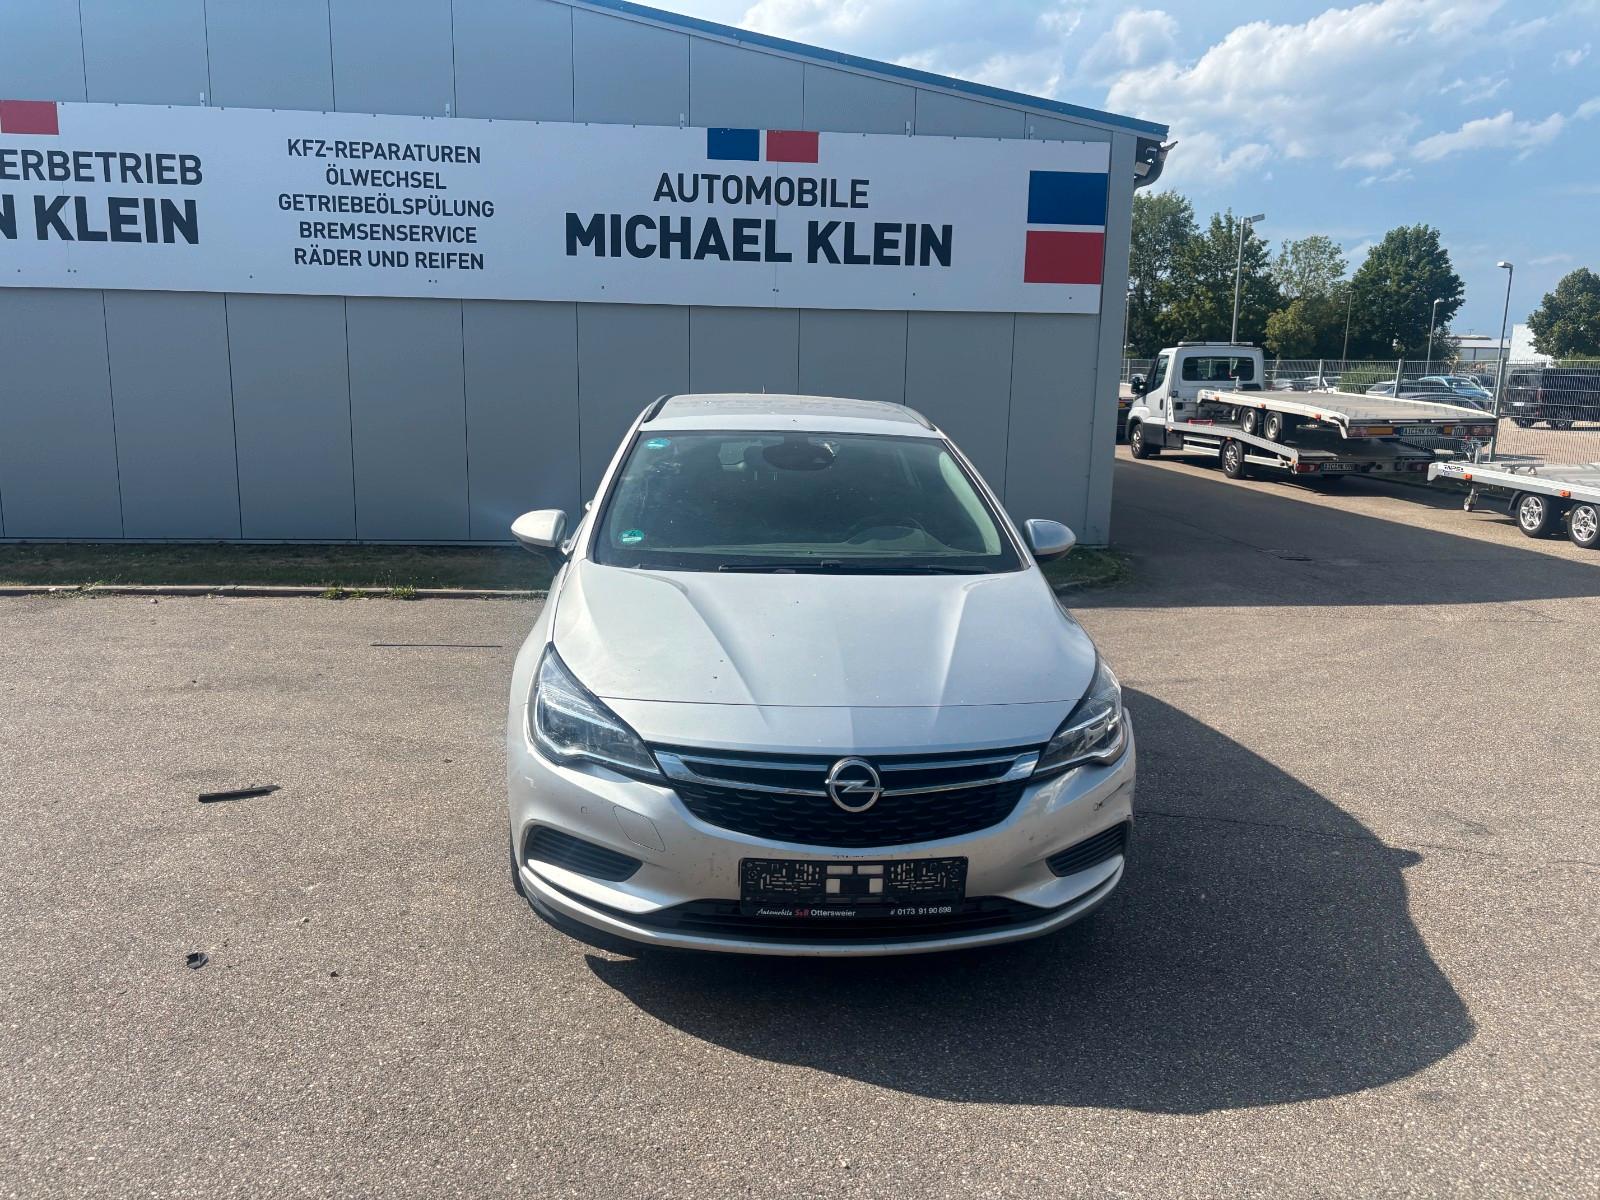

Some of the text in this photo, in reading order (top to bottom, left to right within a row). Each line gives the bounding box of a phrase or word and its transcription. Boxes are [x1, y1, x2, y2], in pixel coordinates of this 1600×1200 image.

[287, 138, 481, 164] KFZ-REPARATUREN
[326, 163, 447, 190] ÖLWECHSEL
[652, 172, 870, 210] AUTOMOBILE
[278, 192, 495, 218] GETRIEBEÖLSPÜLUNG
[33, 194, 200, 245] KLEIN
[299, 220, 478, 244] BREMSENSERVICE
[565, 212, 953, 267] MICHAEL KLEIN
[294, 243, 484, 270] RÄDER UND REIFEN
[810, 908, 857, 917] Ottersweier
